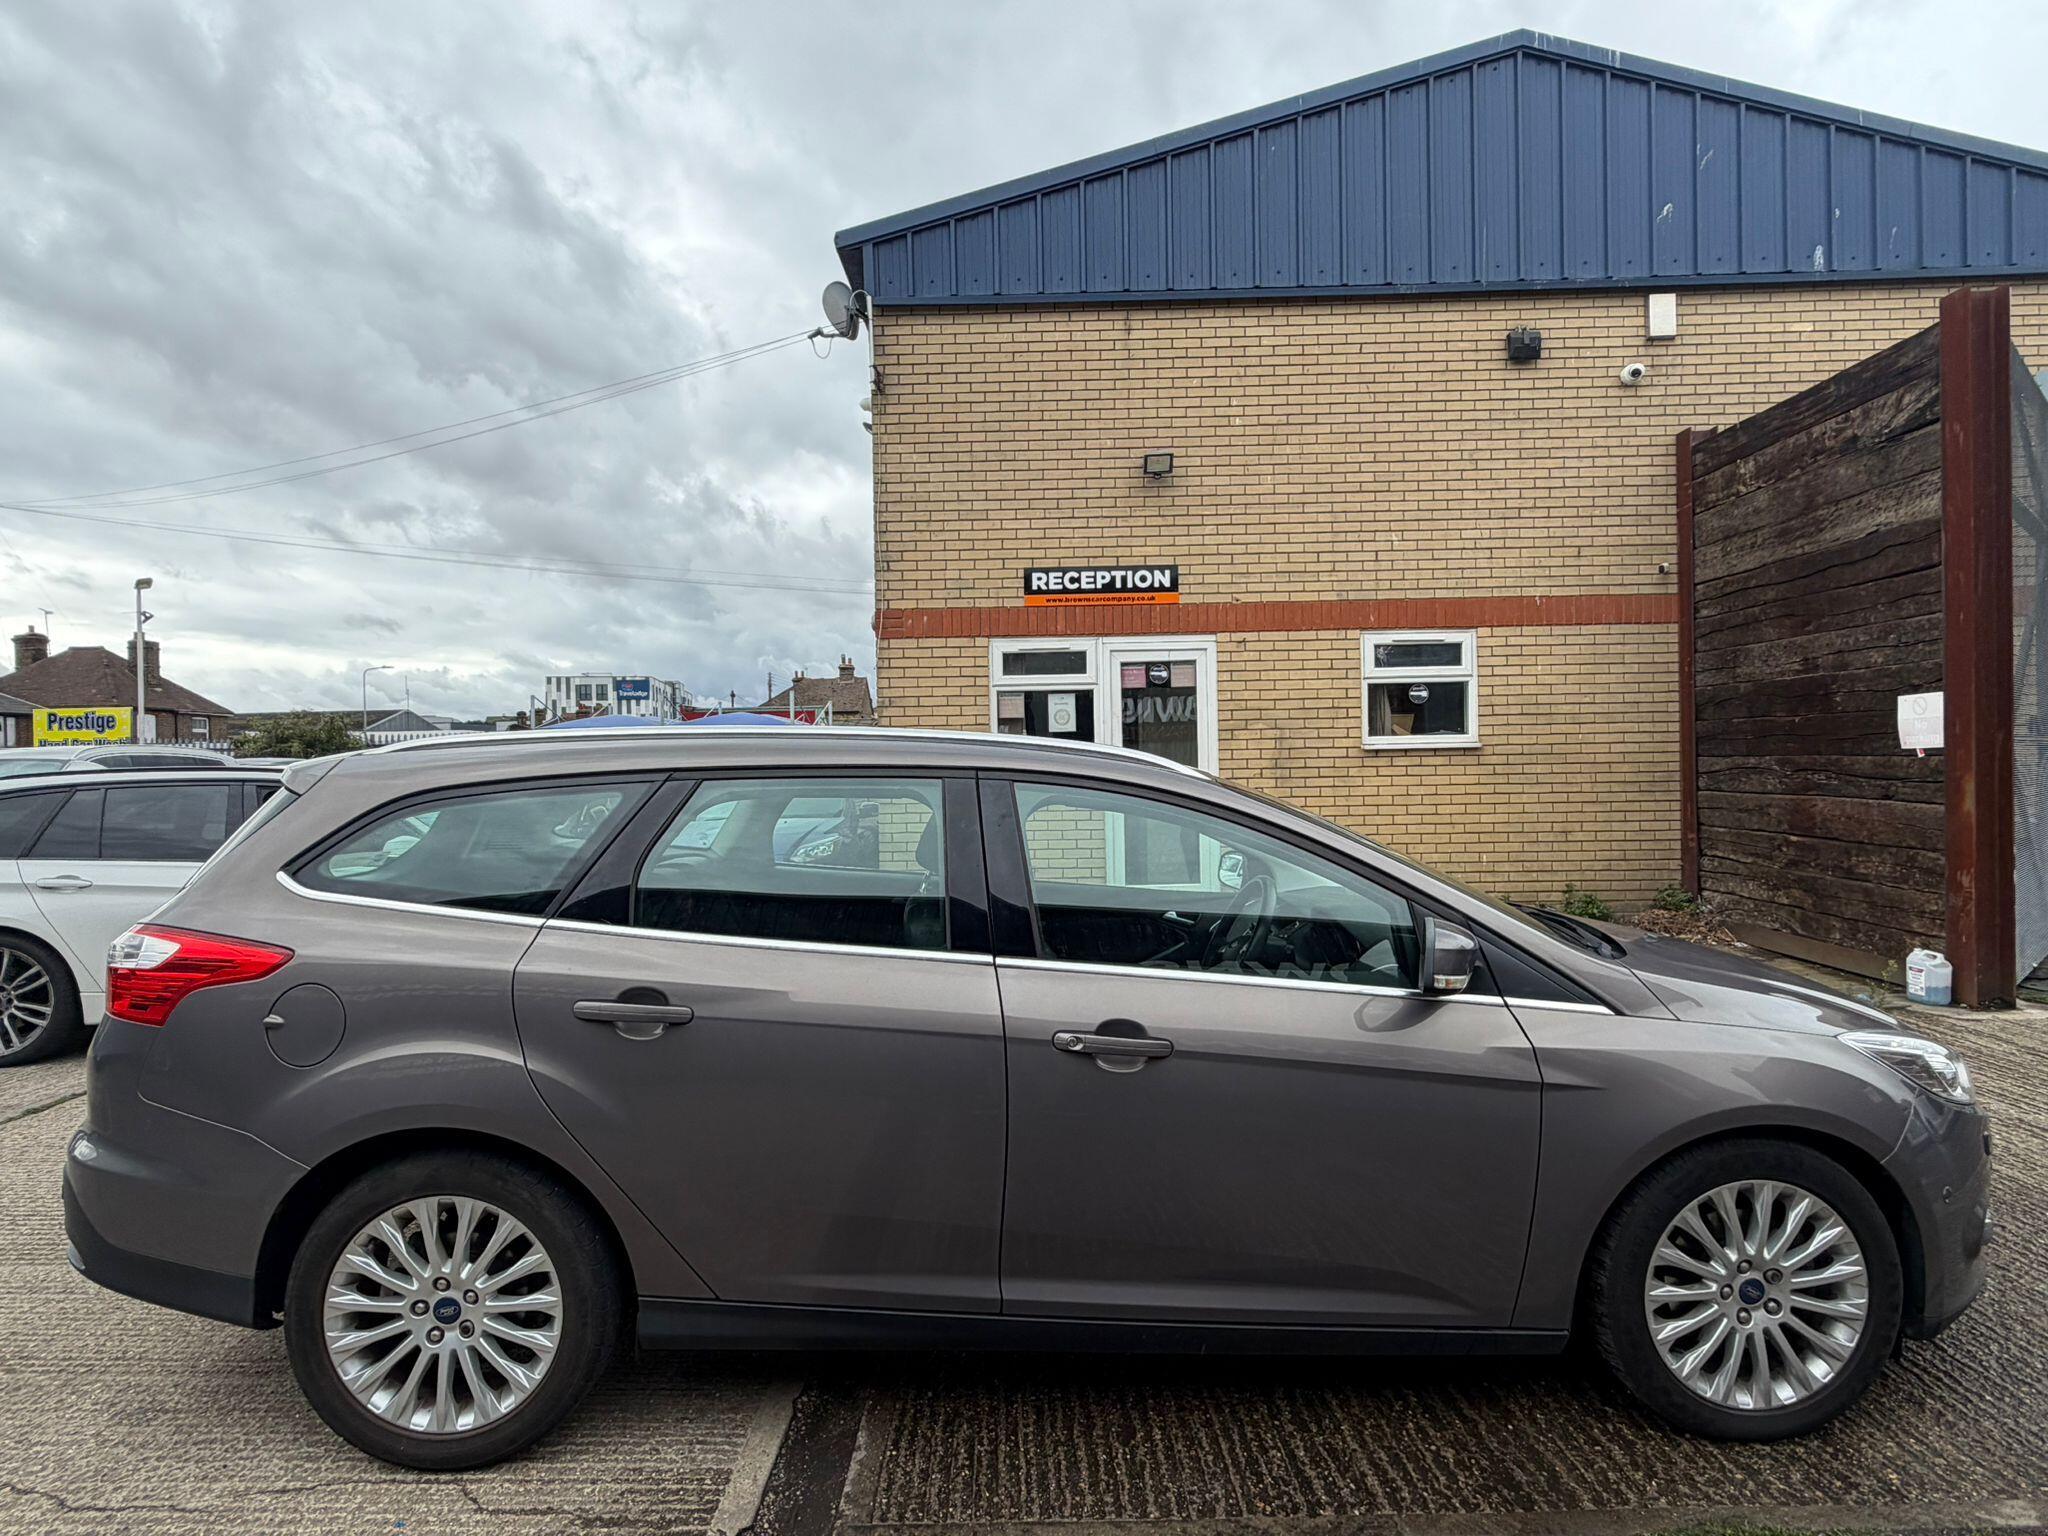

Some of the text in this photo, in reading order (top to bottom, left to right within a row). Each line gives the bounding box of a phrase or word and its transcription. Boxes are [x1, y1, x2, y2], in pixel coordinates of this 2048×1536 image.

[1031, 569, 1171, 590] RECEPTION
[1046, 595, 1156, 604] www.brownscarcompany.co.uk
[46, 710, 117, 734] Prestige
